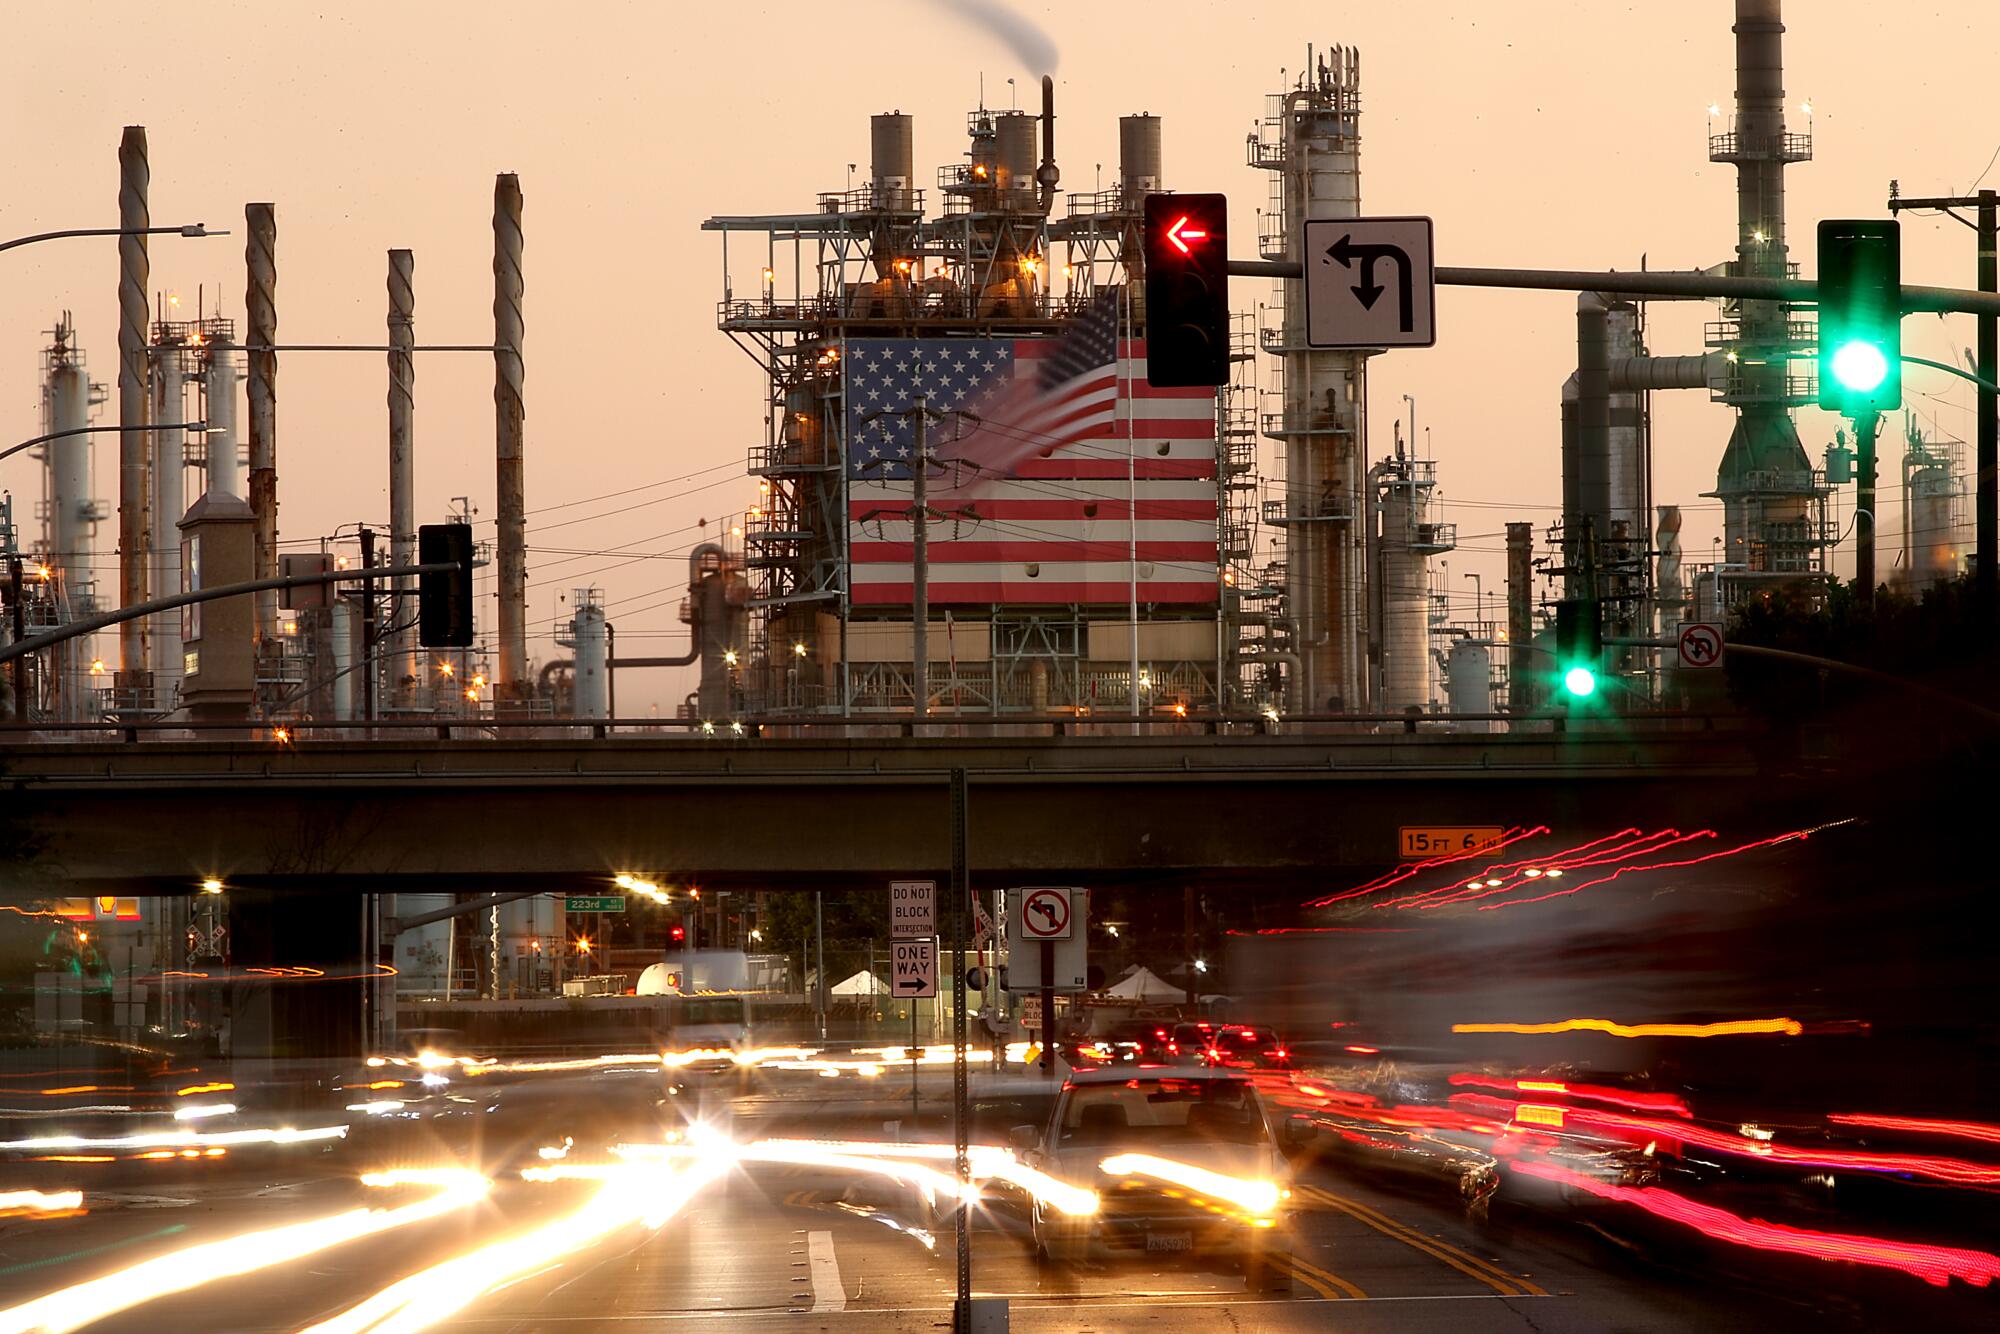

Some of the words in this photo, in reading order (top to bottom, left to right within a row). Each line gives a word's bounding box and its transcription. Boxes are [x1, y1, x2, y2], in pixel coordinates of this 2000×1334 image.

[1408, 834, 1429, 850] 15
[1433, 840, 1449, 850] FT
[1463, 834, 1475, 849] 6
[893, 888, 907, 899] DO
[911, 888, 931, 899] NOT
[571, 900, 600, 909] 223rd
[895, 907, 930, 917] BLOCK
[898, 947, 928, 959] ONE
[897, 962, 929, 975] WAY
